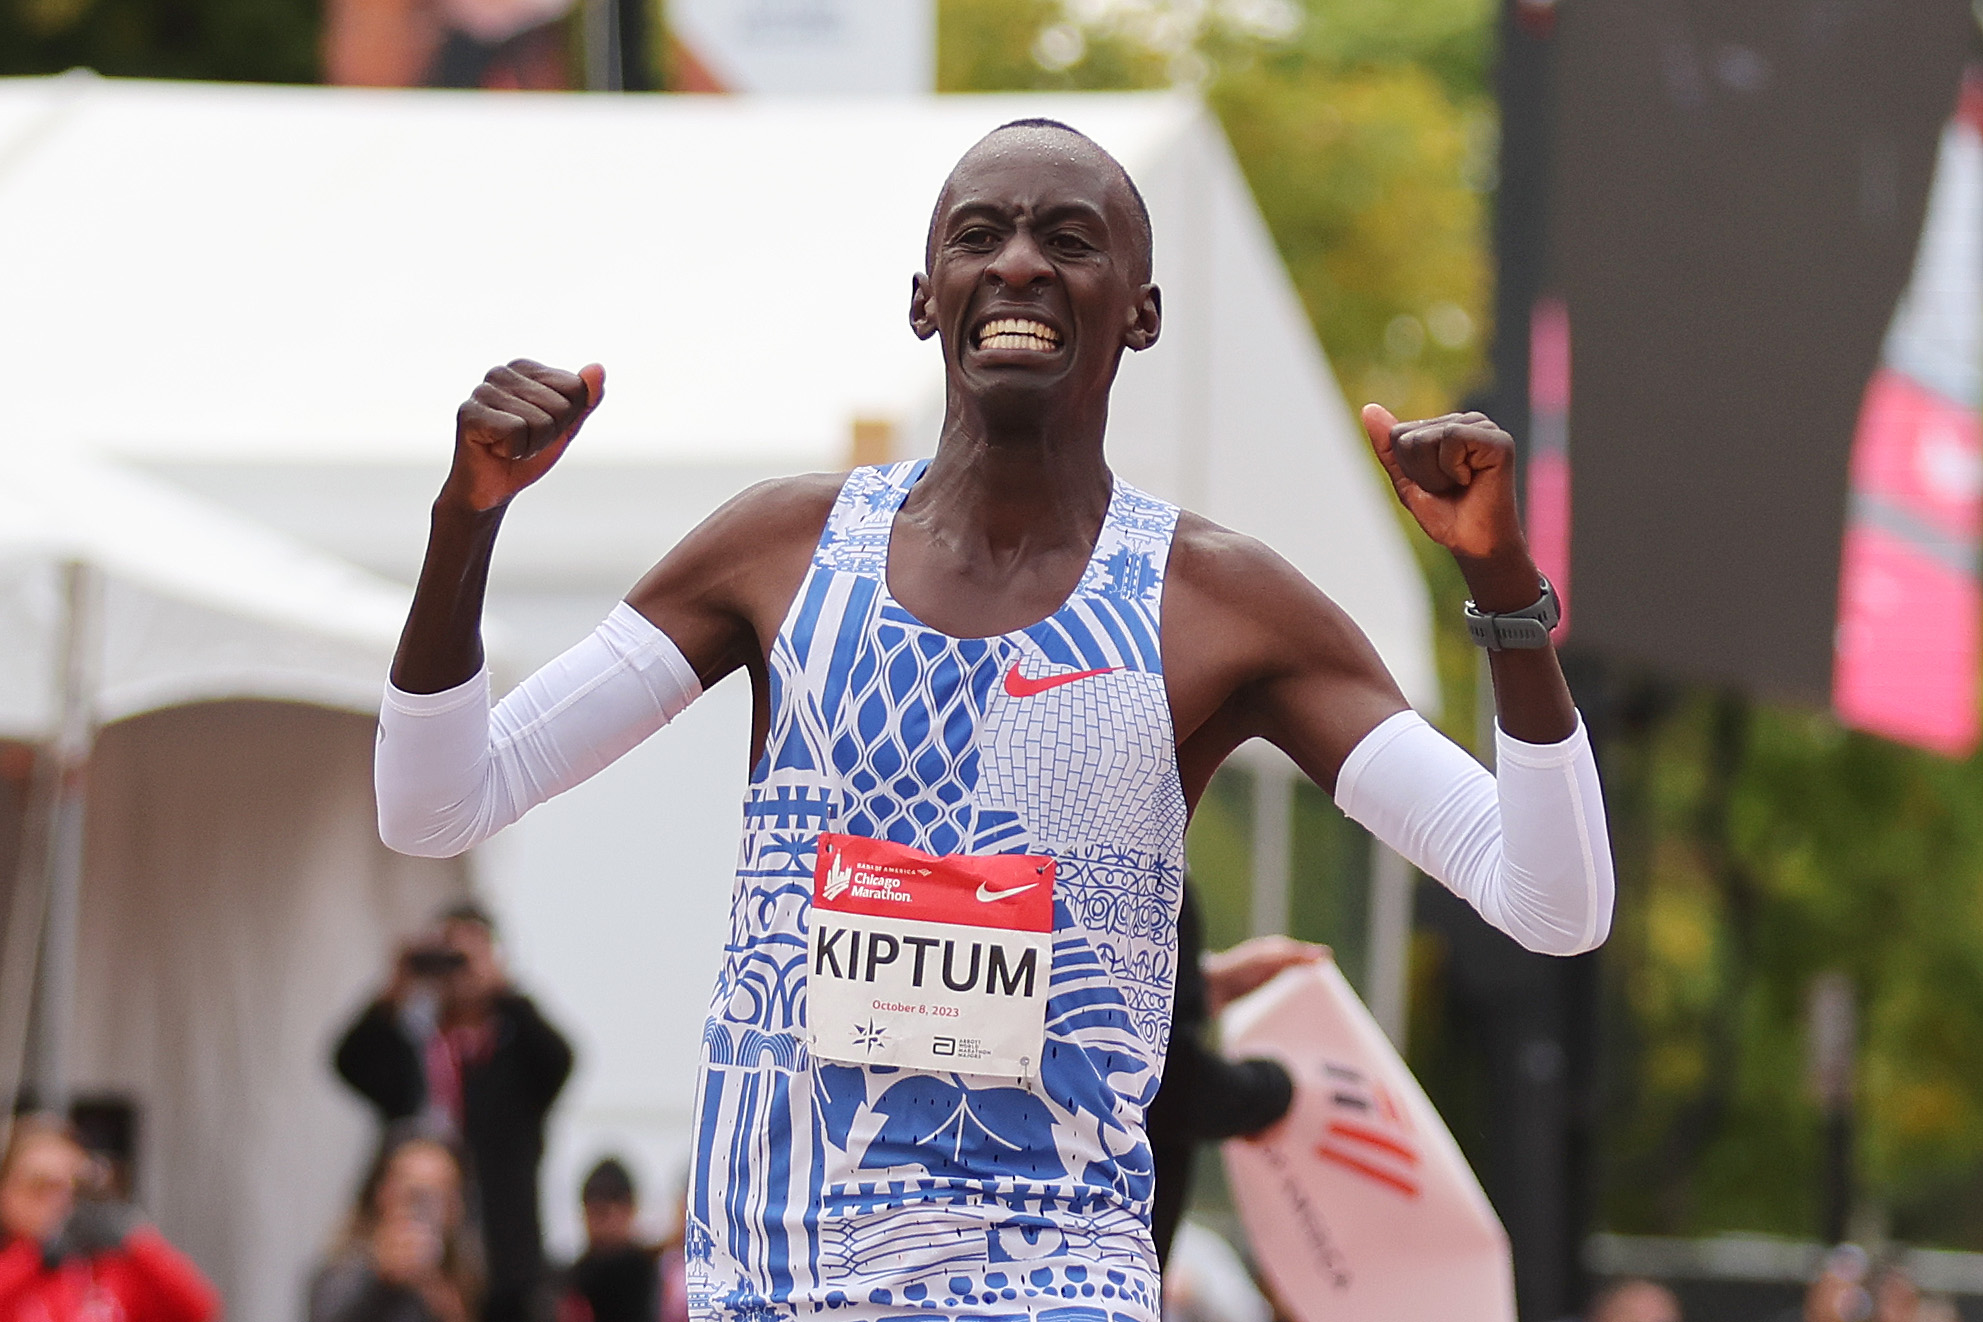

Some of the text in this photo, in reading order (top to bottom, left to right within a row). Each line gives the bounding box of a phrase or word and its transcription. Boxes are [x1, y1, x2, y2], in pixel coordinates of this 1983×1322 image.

[857, 862, 874, 870] BANK
[883, 867, 916, 875] AMERICA
[854, 872, 901, 889] Chicago
[814, 925, 1038, 998] KIPTUM
[872, 999, 960, 1018] October 8, 2023
